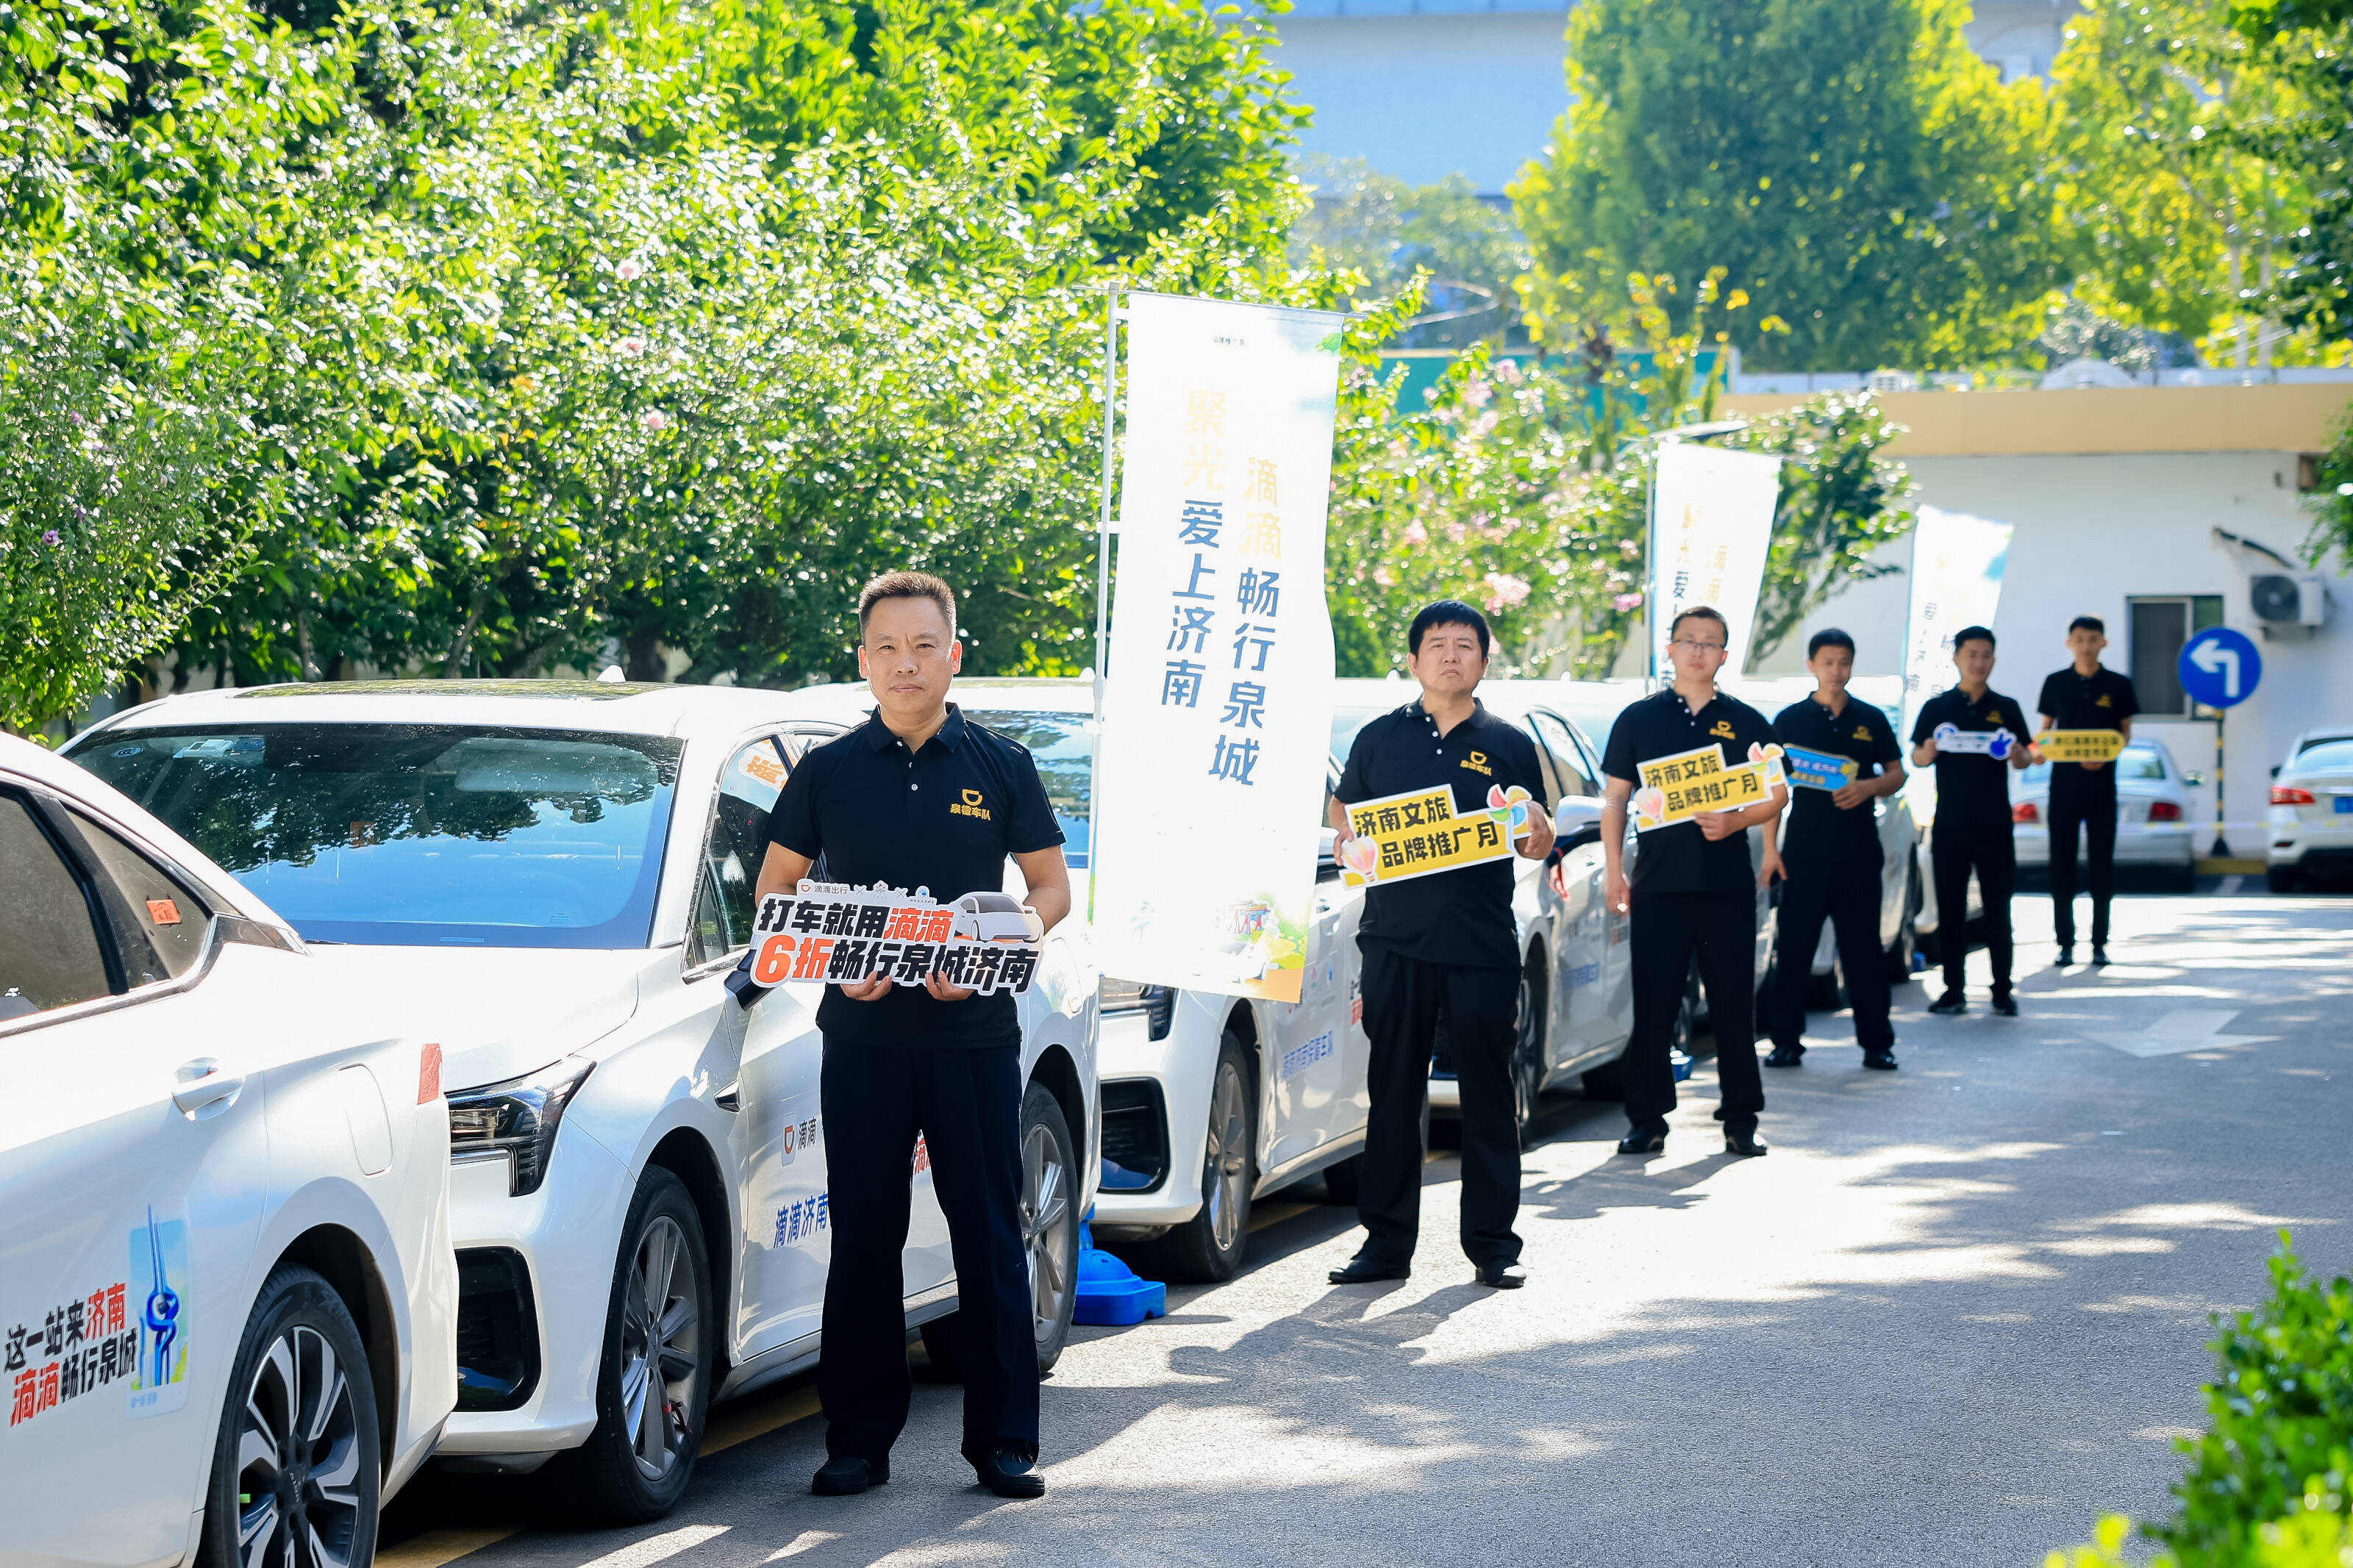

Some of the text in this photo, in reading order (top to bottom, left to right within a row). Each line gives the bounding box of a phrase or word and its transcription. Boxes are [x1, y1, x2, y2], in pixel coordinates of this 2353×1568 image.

[1208, 457, 1281, 785] 滴滴畅行泉城
[1644, 755, 1719, 787] 济南文旅
[1667, 773, 1758, 812] 品牌推广月
[1354, 797, 1450, 837] 济南文旅
[1381, 820, 1499, 868] 品牌推广月
[814, 885, 848, 895] 滴滴出行
[757, 898, 955, 943] 打车就用滴滴
[754, 934, 1039, 993] 6折畅行泉城济南
[774, 1191, 829, 1249] 滴滴济南
[4, 1282, 127, 1373] 这一站来济南
[10, 1325, 138, 1428] 滴滴畅行泉城
